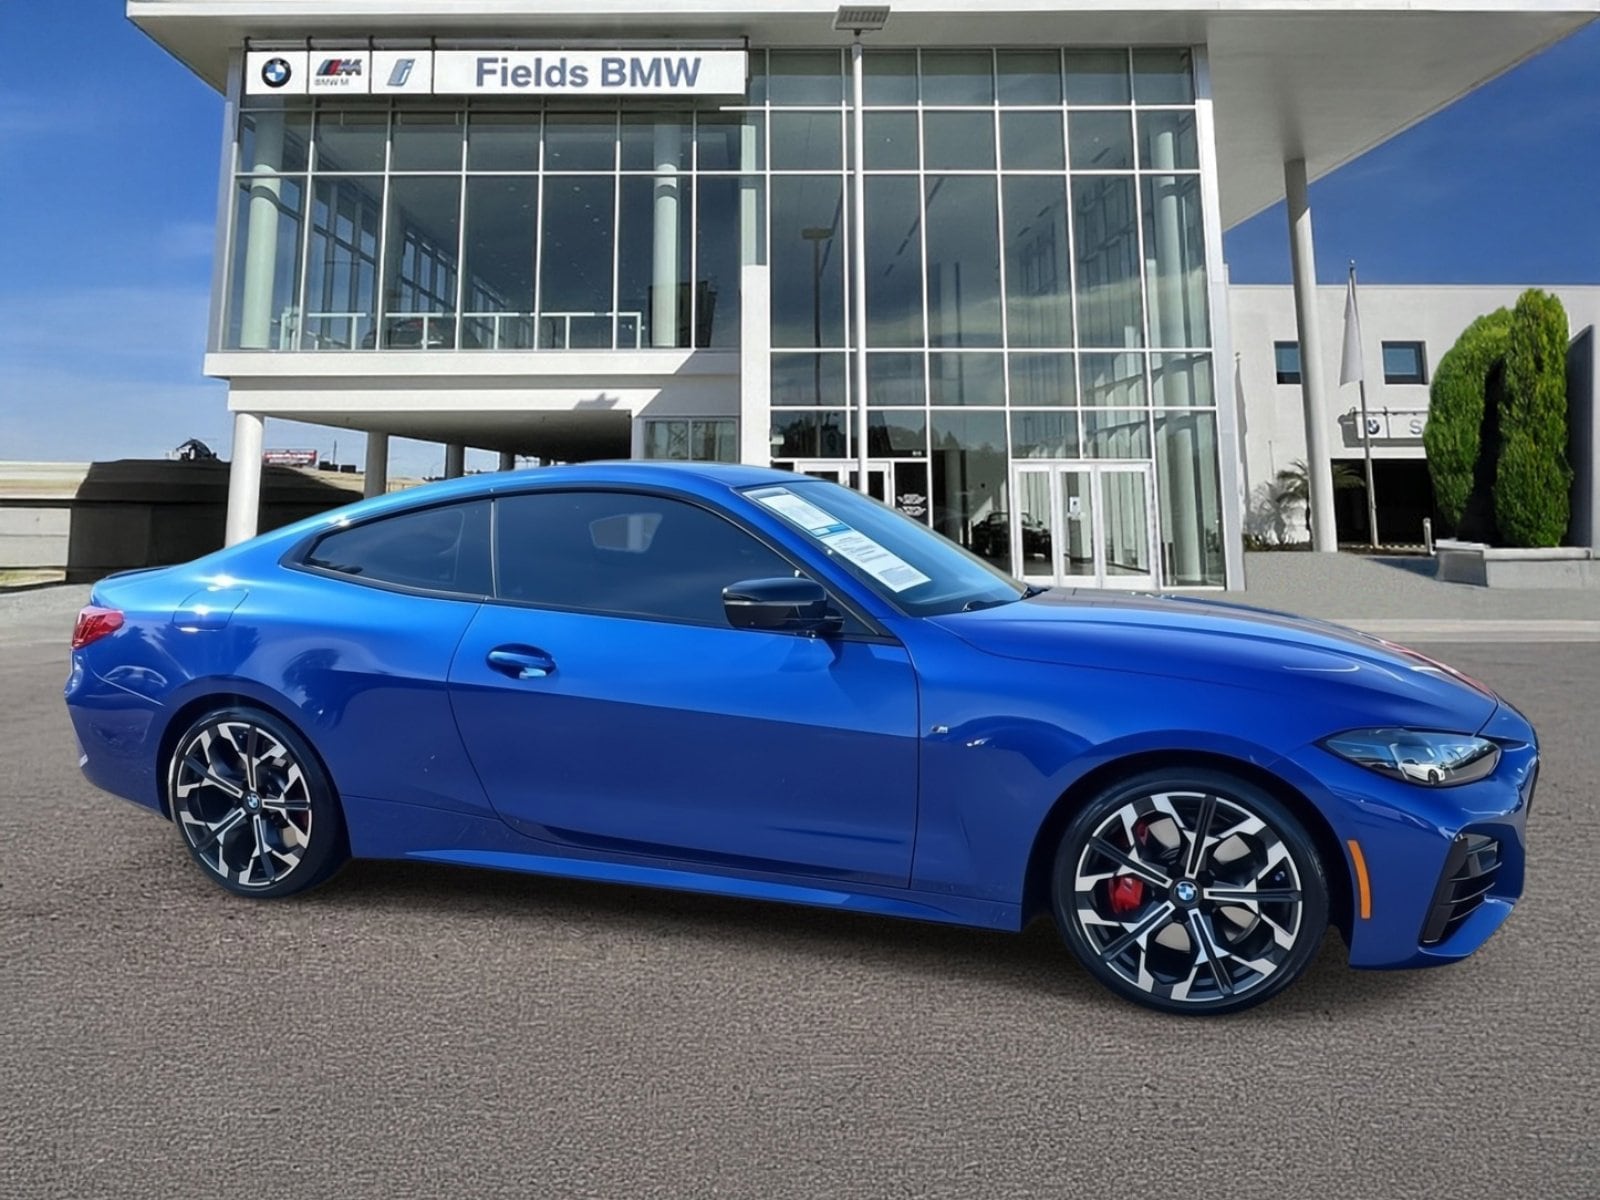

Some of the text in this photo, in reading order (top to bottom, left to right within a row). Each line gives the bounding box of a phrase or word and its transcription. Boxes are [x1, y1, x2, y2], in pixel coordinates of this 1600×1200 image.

[476, 57, 702, 87] Fields BMW
[314, 78, 338, 86] BMW
